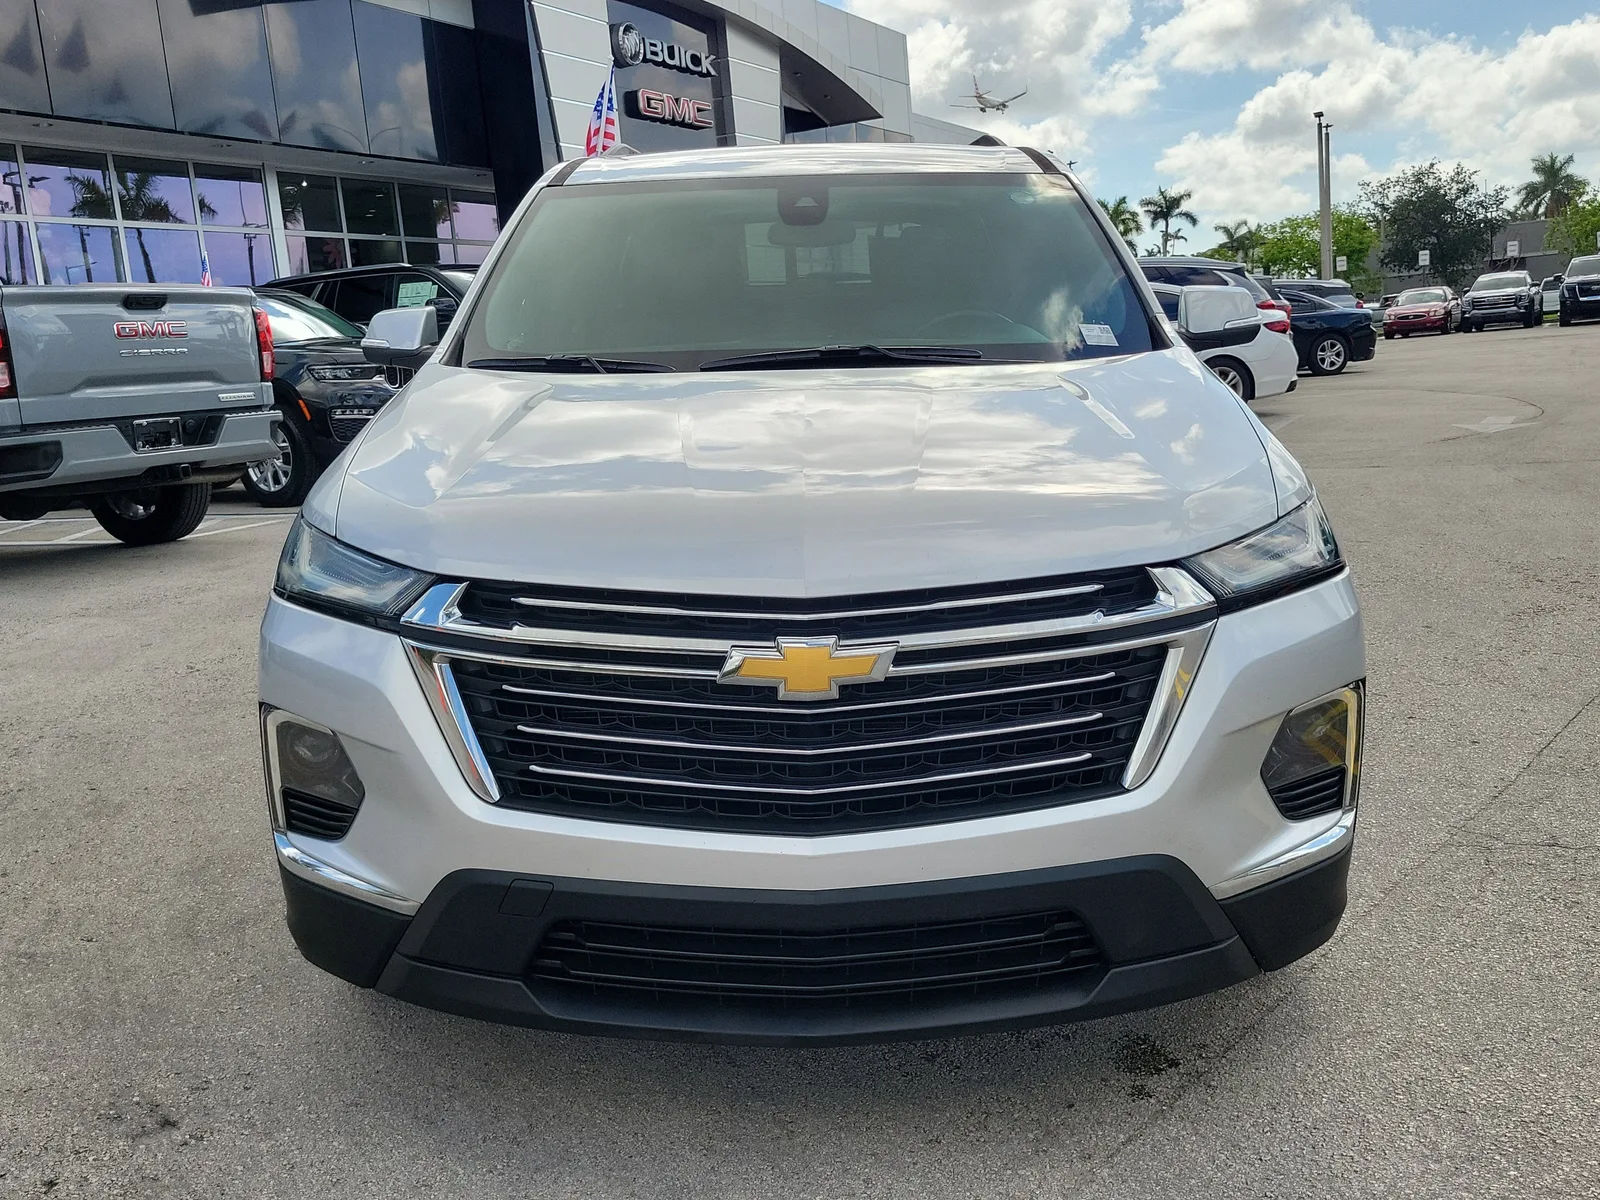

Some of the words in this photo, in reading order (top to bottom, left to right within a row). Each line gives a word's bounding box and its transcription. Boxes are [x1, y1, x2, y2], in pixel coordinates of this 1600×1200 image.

[644, 38, 717, 76] BUICK
[638, 88, 714, 127] GMC
[113, 321, 188, 339] GMC
[119, 348, 189, 357] SIERRA
